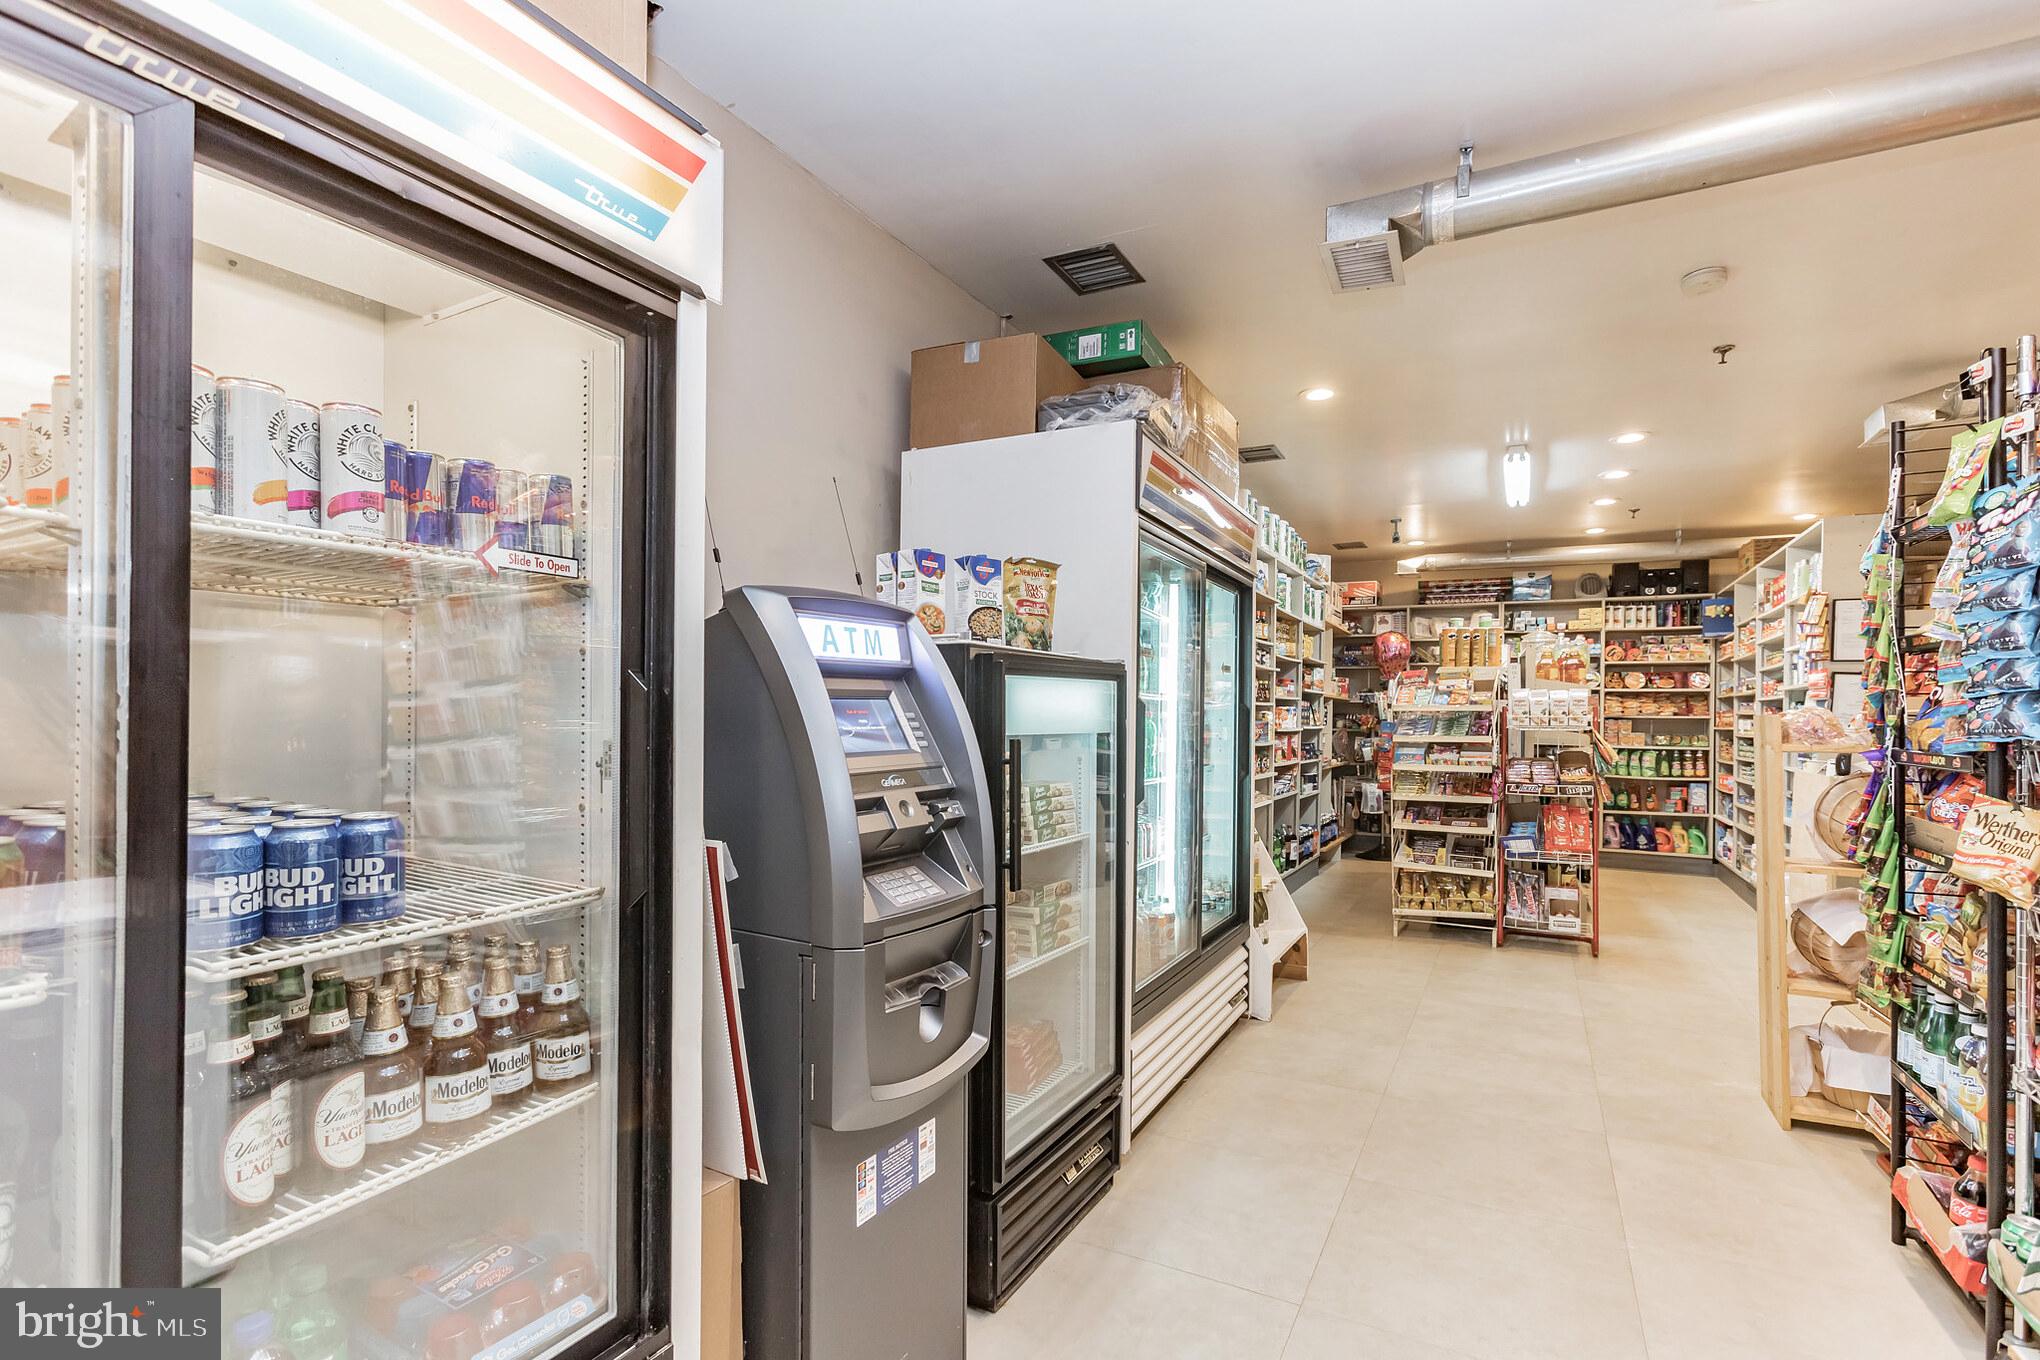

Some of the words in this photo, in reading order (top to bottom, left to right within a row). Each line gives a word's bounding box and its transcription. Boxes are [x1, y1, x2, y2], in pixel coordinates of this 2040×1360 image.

[337, 424, 360, 457] WHITE
[349, 462, 373, 479] HARD
[508, 553, 531, 567] Slide
[534, 556, 546, 569] To
[547, 559, 571, 574] Open
[974, 590, 999, 601] STOCK
[822, 624, 884, 657] ATM
[1980, 831, 2035, 860] Original
[265, 867, 325, 888] BUD
[538, 1042, 582, 1060] Modelo
[488, 1051, 530, 1074] Modelo
[437, 1075, 488, 1099] Modelo
